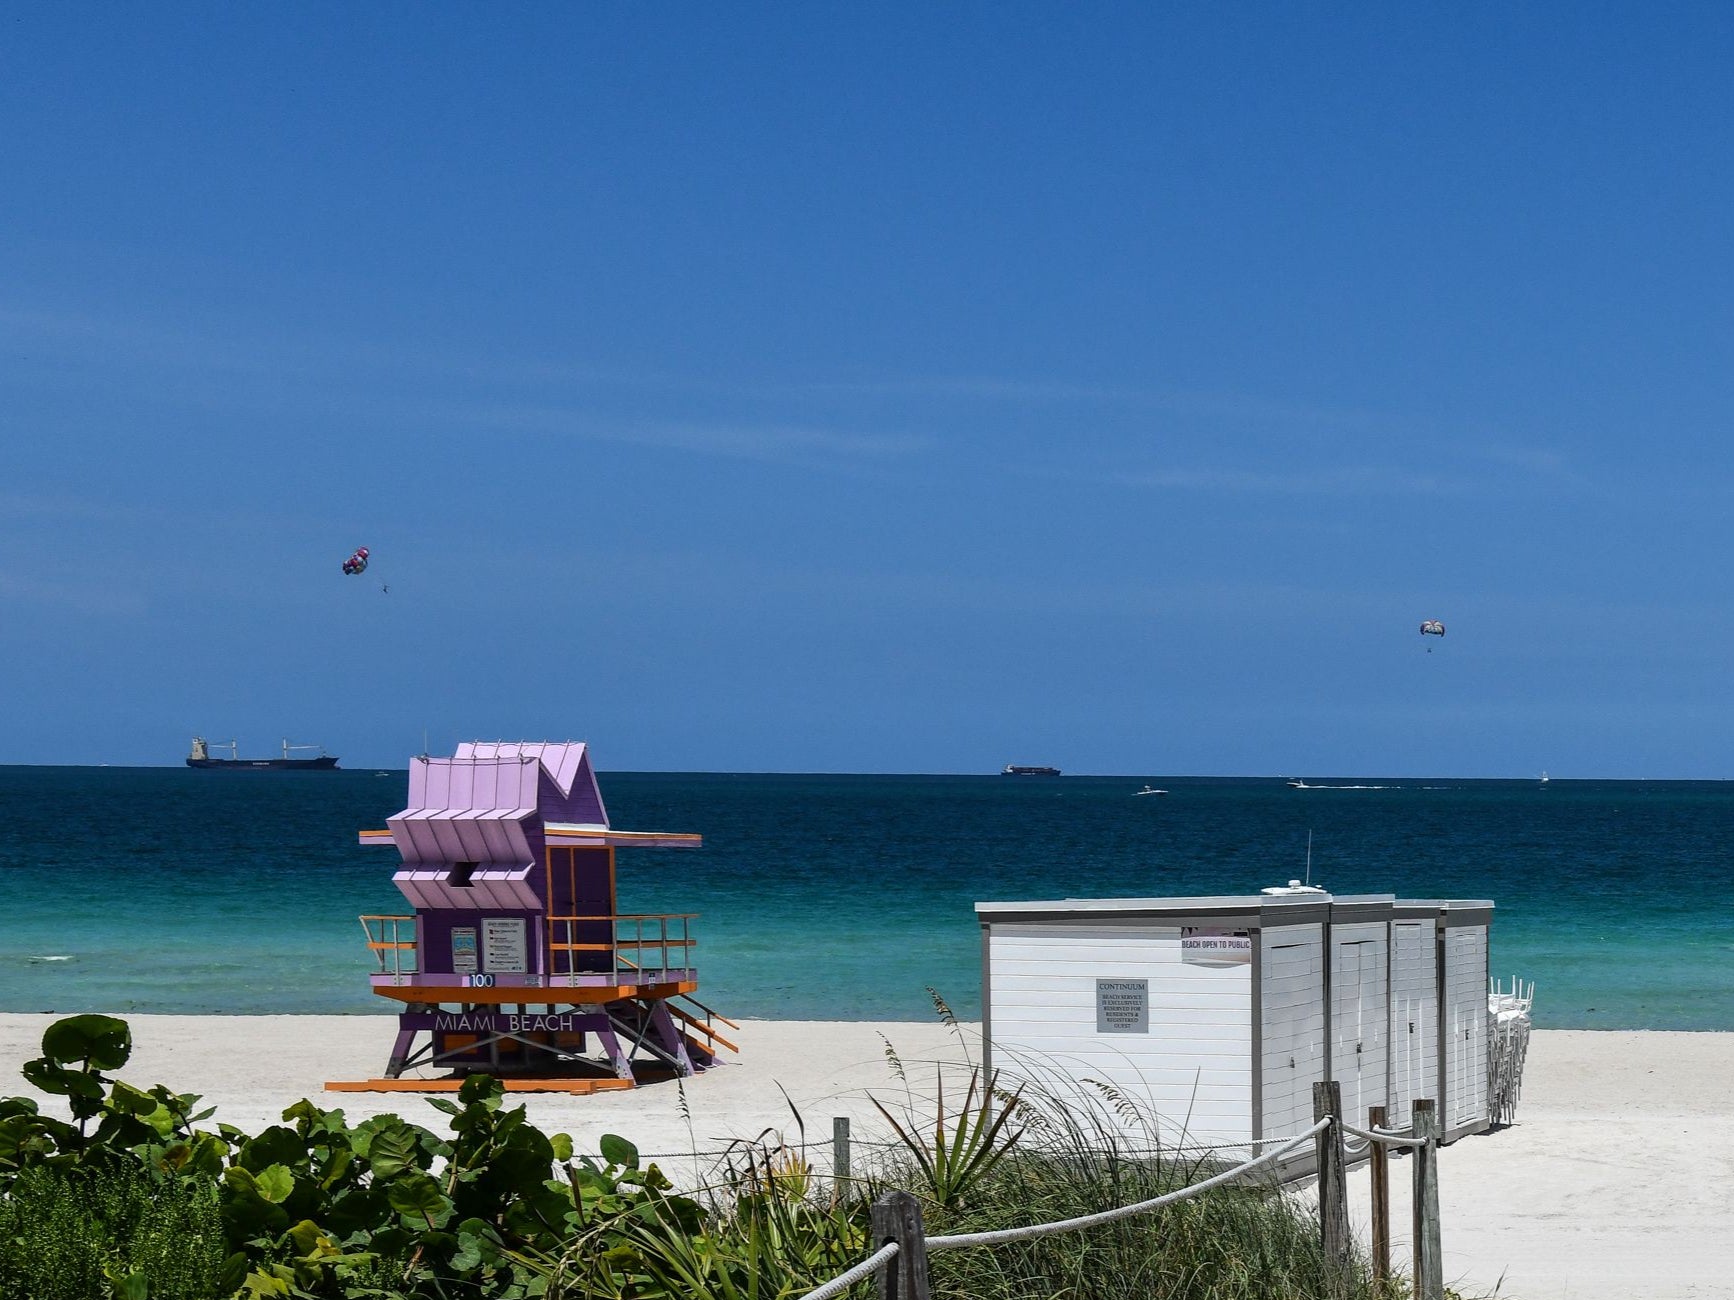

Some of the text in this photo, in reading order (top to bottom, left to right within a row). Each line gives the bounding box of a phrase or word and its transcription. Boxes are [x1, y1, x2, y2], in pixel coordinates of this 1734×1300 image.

[1181, 940, 1250, 949] BEACH OPEN TO PUBLIC
[471, 974, 493, 988] 100
[435, 1015, 573, 1031] MIAMI BEACH
